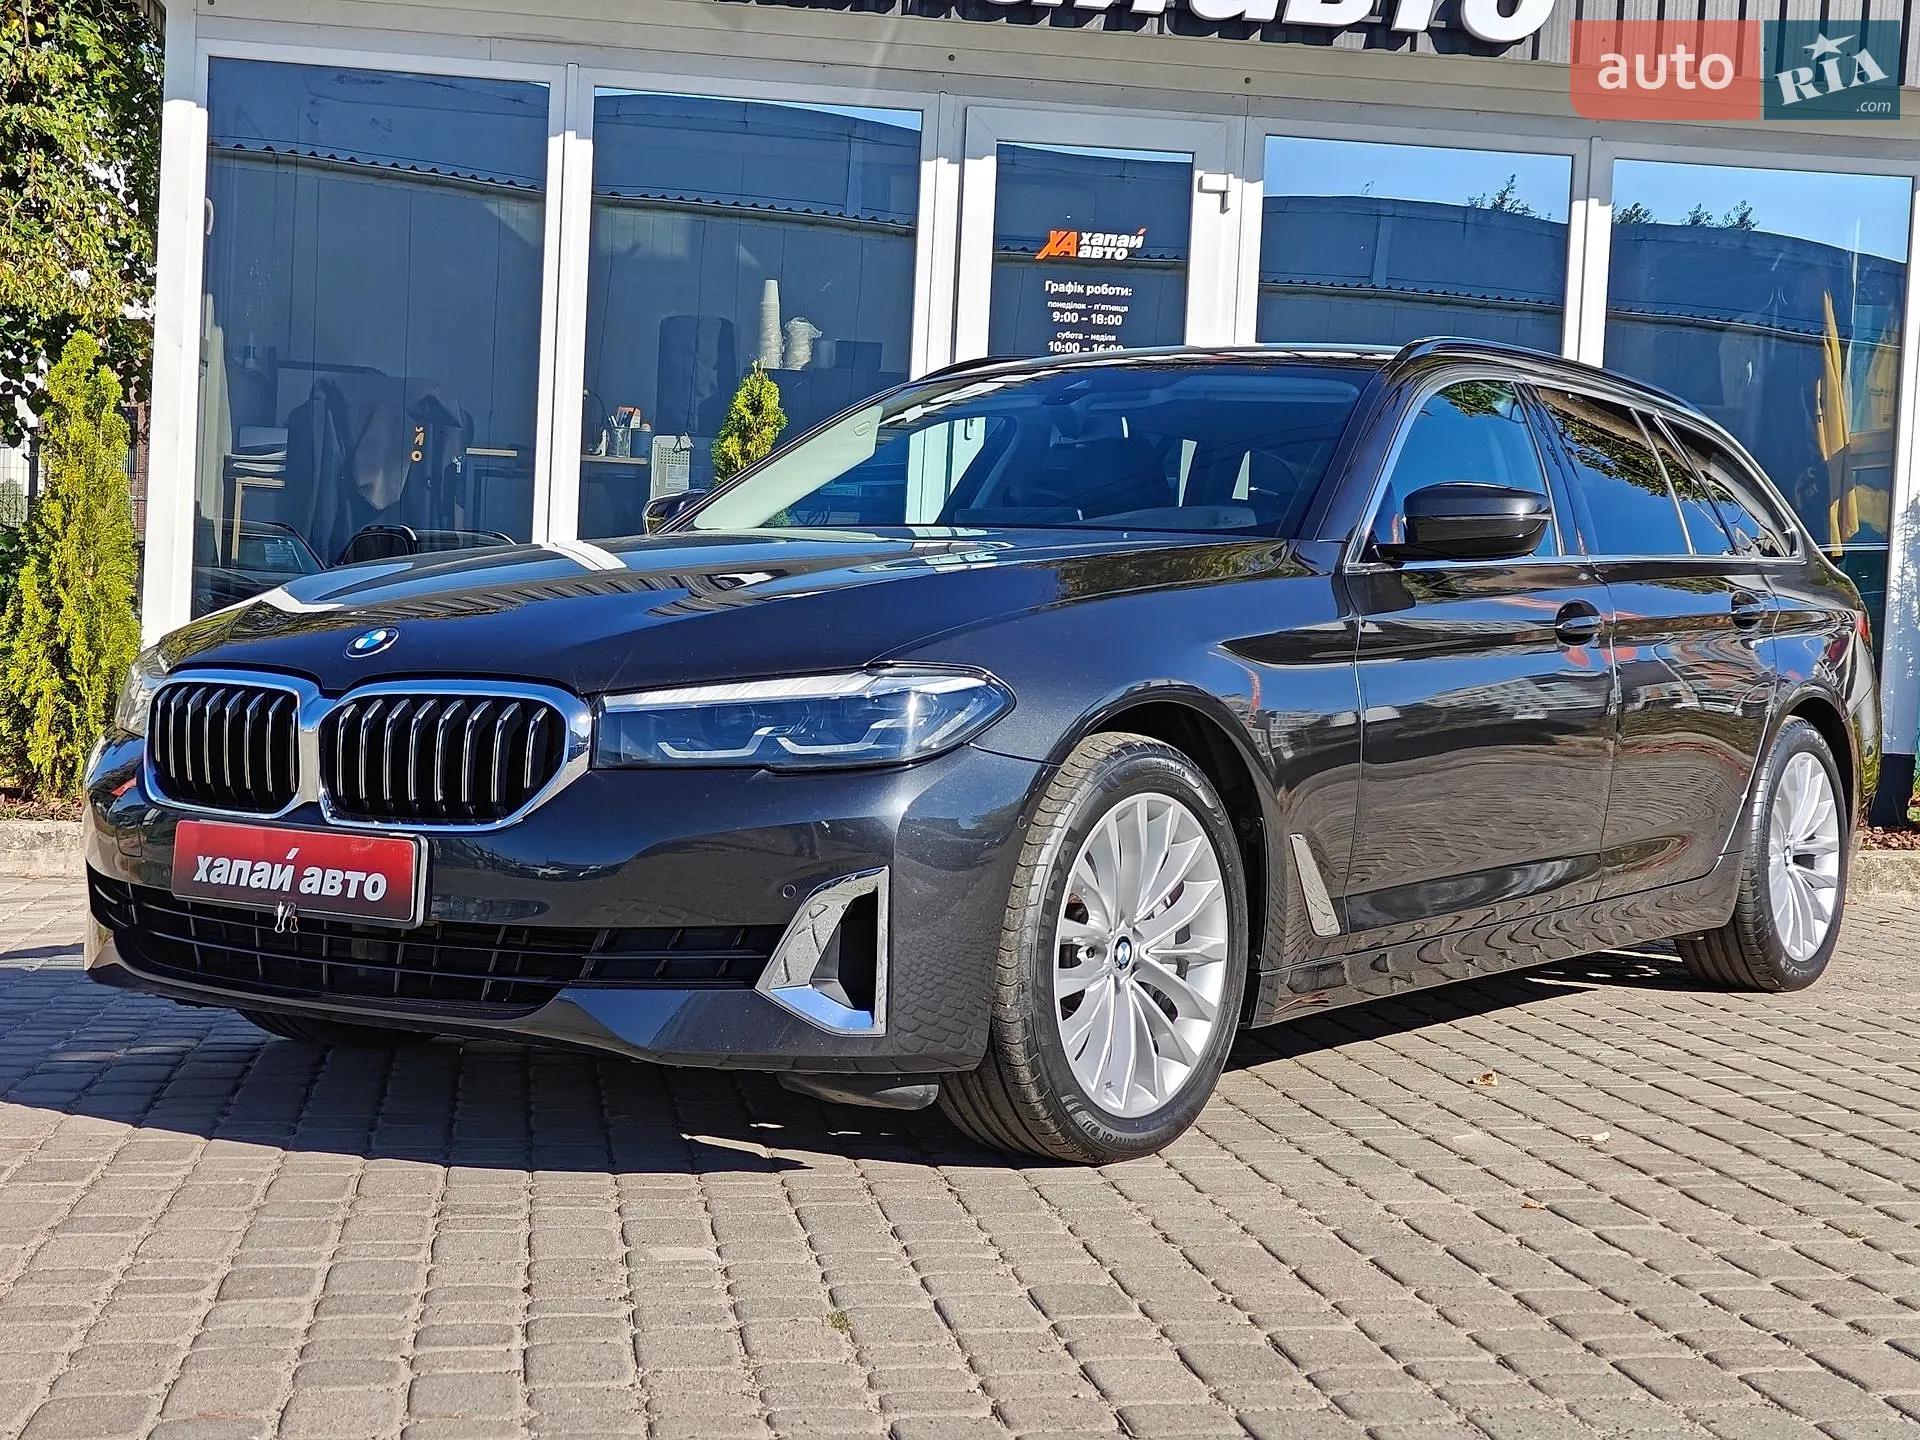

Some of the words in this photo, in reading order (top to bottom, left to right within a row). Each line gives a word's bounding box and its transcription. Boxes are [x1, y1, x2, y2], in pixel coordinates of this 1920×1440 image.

[1044, 280, 1085, 295] Графік
[1086, 283, 1133, 297] роботи:
[1047, 301, 1087, 310] понеділок
[1052, 311, 1079, 323] 9:00
[1090, 313, 1123, 326] 18:00
[1056, 331, 1084, 340] субота
[1090, 333, 1117, 342] неділя
[1048, 341, 1080, 353] 10:00
[299, 866, 387, 902] авто
